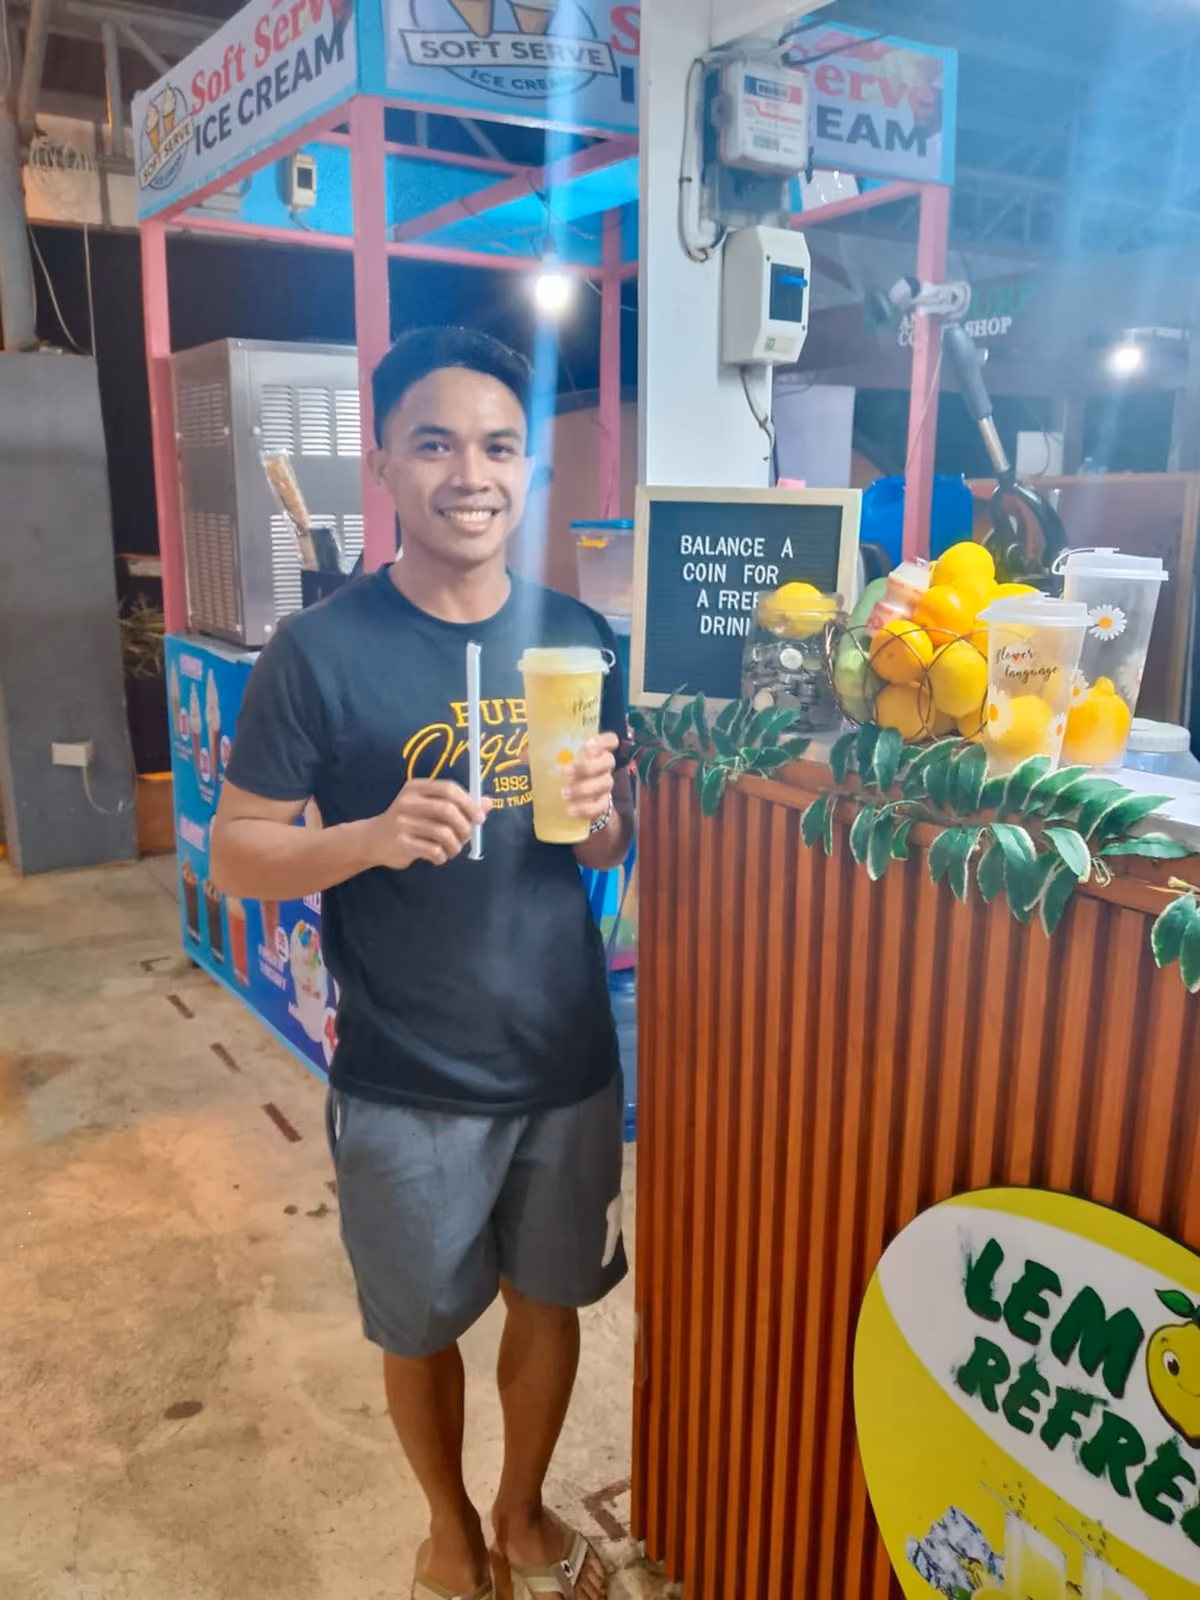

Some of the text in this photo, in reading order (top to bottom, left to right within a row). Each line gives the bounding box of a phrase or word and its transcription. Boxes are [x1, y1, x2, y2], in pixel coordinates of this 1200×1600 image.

[420, 40, 606, 67] SOFT SERVE
[191, 42, 246, 117] Soft
[470, 69, 504, 89] ICE
[195, 34, 344, 156] ICE CREAM
[163, 123, 191, 157] SERVE
[816, 104, 928, 158] EAM
[680, 535, 794, 559] BALANCE A
[682, 562, 779, 585] COIN FOR
[696, 589, 710, 609] A
[1004, 664, 1059, 683] language
[492, 774, 529, 792] 1992
[506, 792, 534, 807] TRAD
[963, 1234, 1200, 1402] LEM
